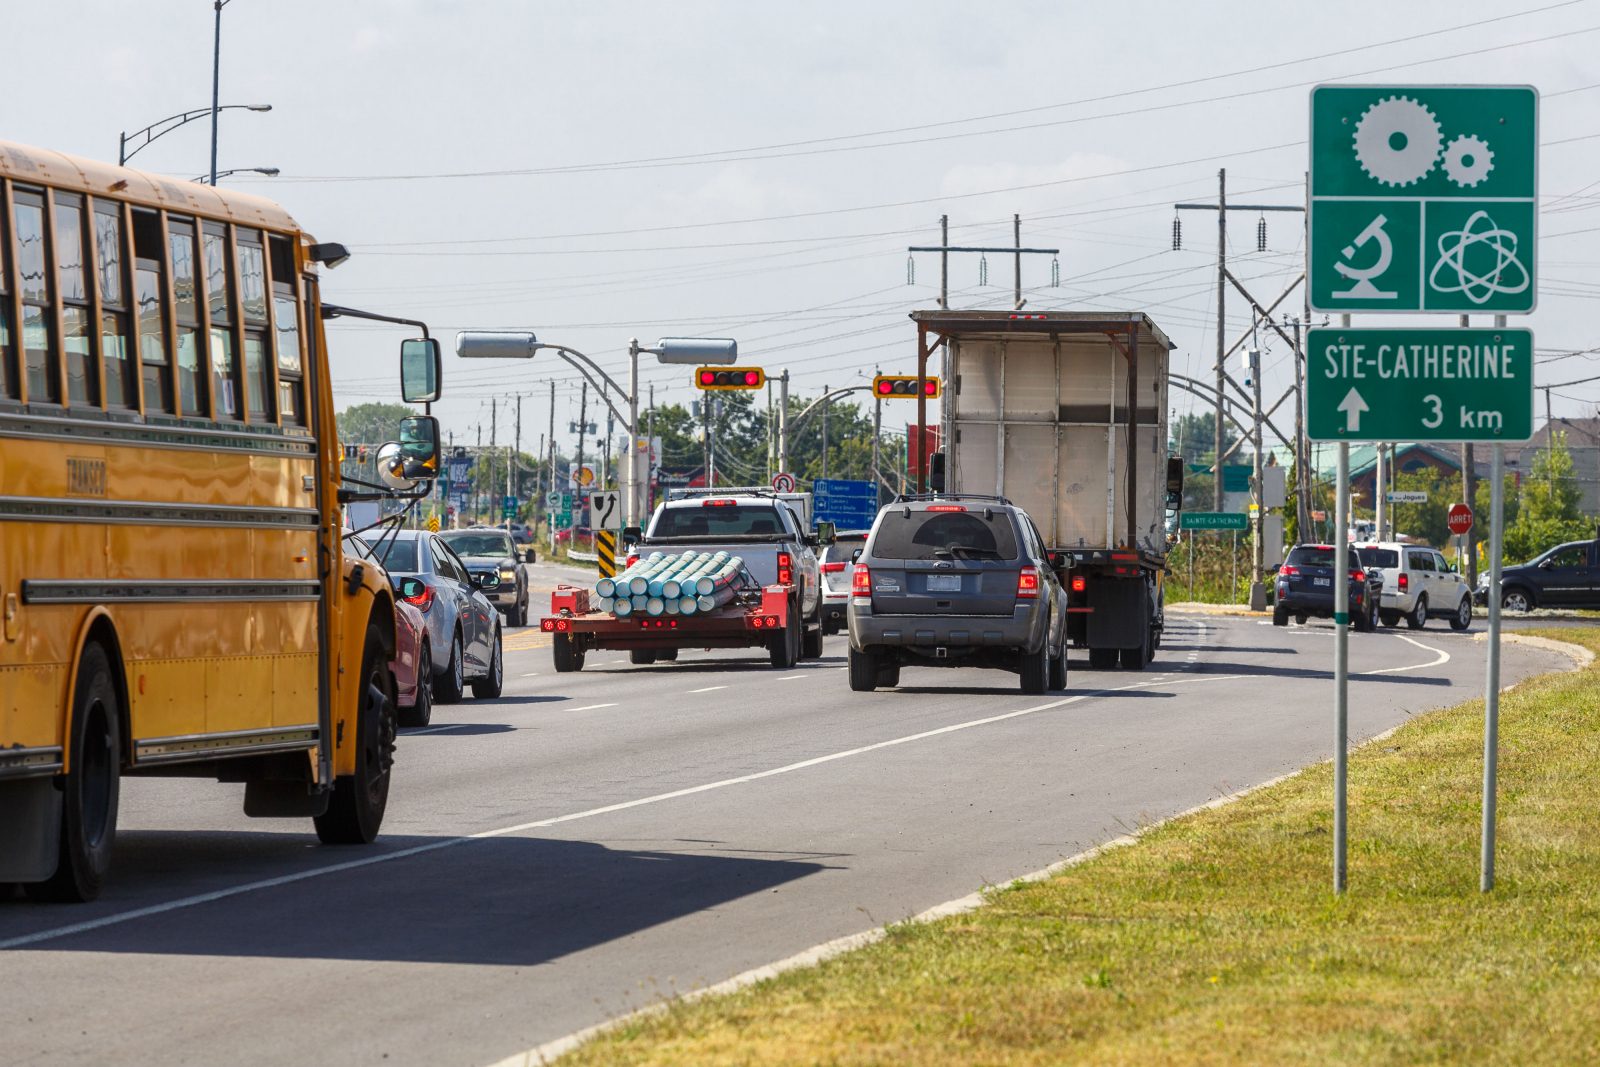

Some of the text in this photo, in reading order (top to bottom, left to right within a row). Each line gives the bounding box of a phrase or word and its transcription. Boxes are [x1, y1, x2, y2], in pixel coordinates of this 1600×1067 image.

[1325, 345, 1515, 379] STE-CATHERINE
[1421, 394, 1503, 429] 3 km
[1449, 513, 1472, 525] ARRÊT
